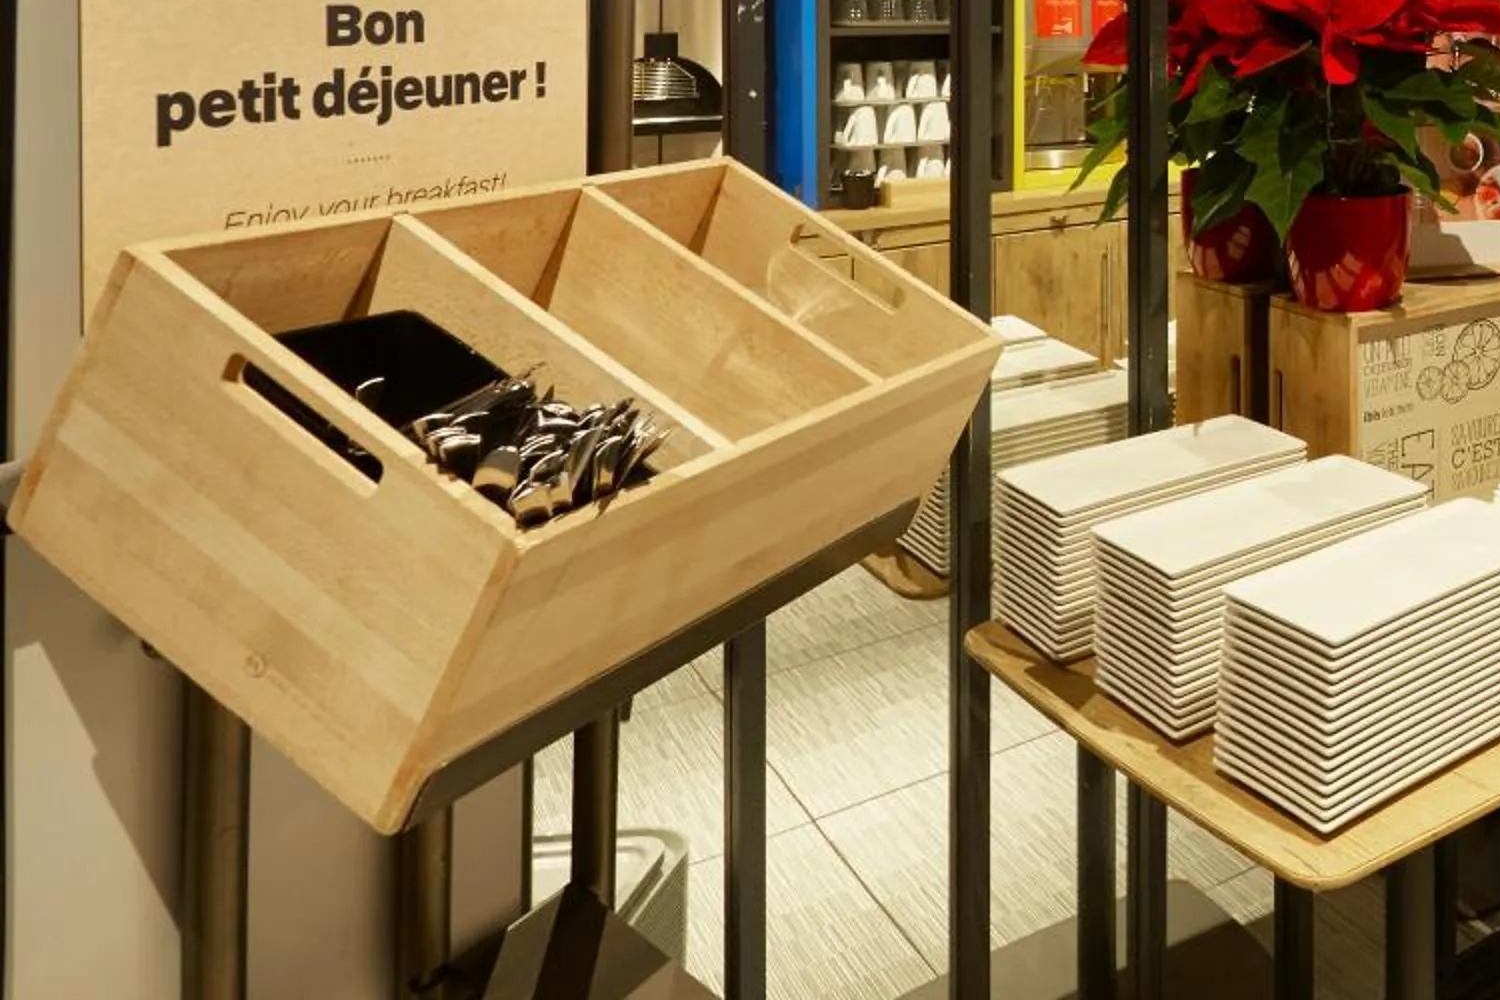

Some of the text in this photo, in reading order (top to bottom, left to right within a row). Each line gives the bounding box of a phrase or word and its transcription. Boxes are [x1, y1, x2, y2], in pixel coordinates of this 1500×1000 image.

[325, 3, 425, 47] Bon
[155, 72, 301, 148] petit
[312, 65, 527, 126] déjeuner
[223, 202, 310, 231] Enjoy
